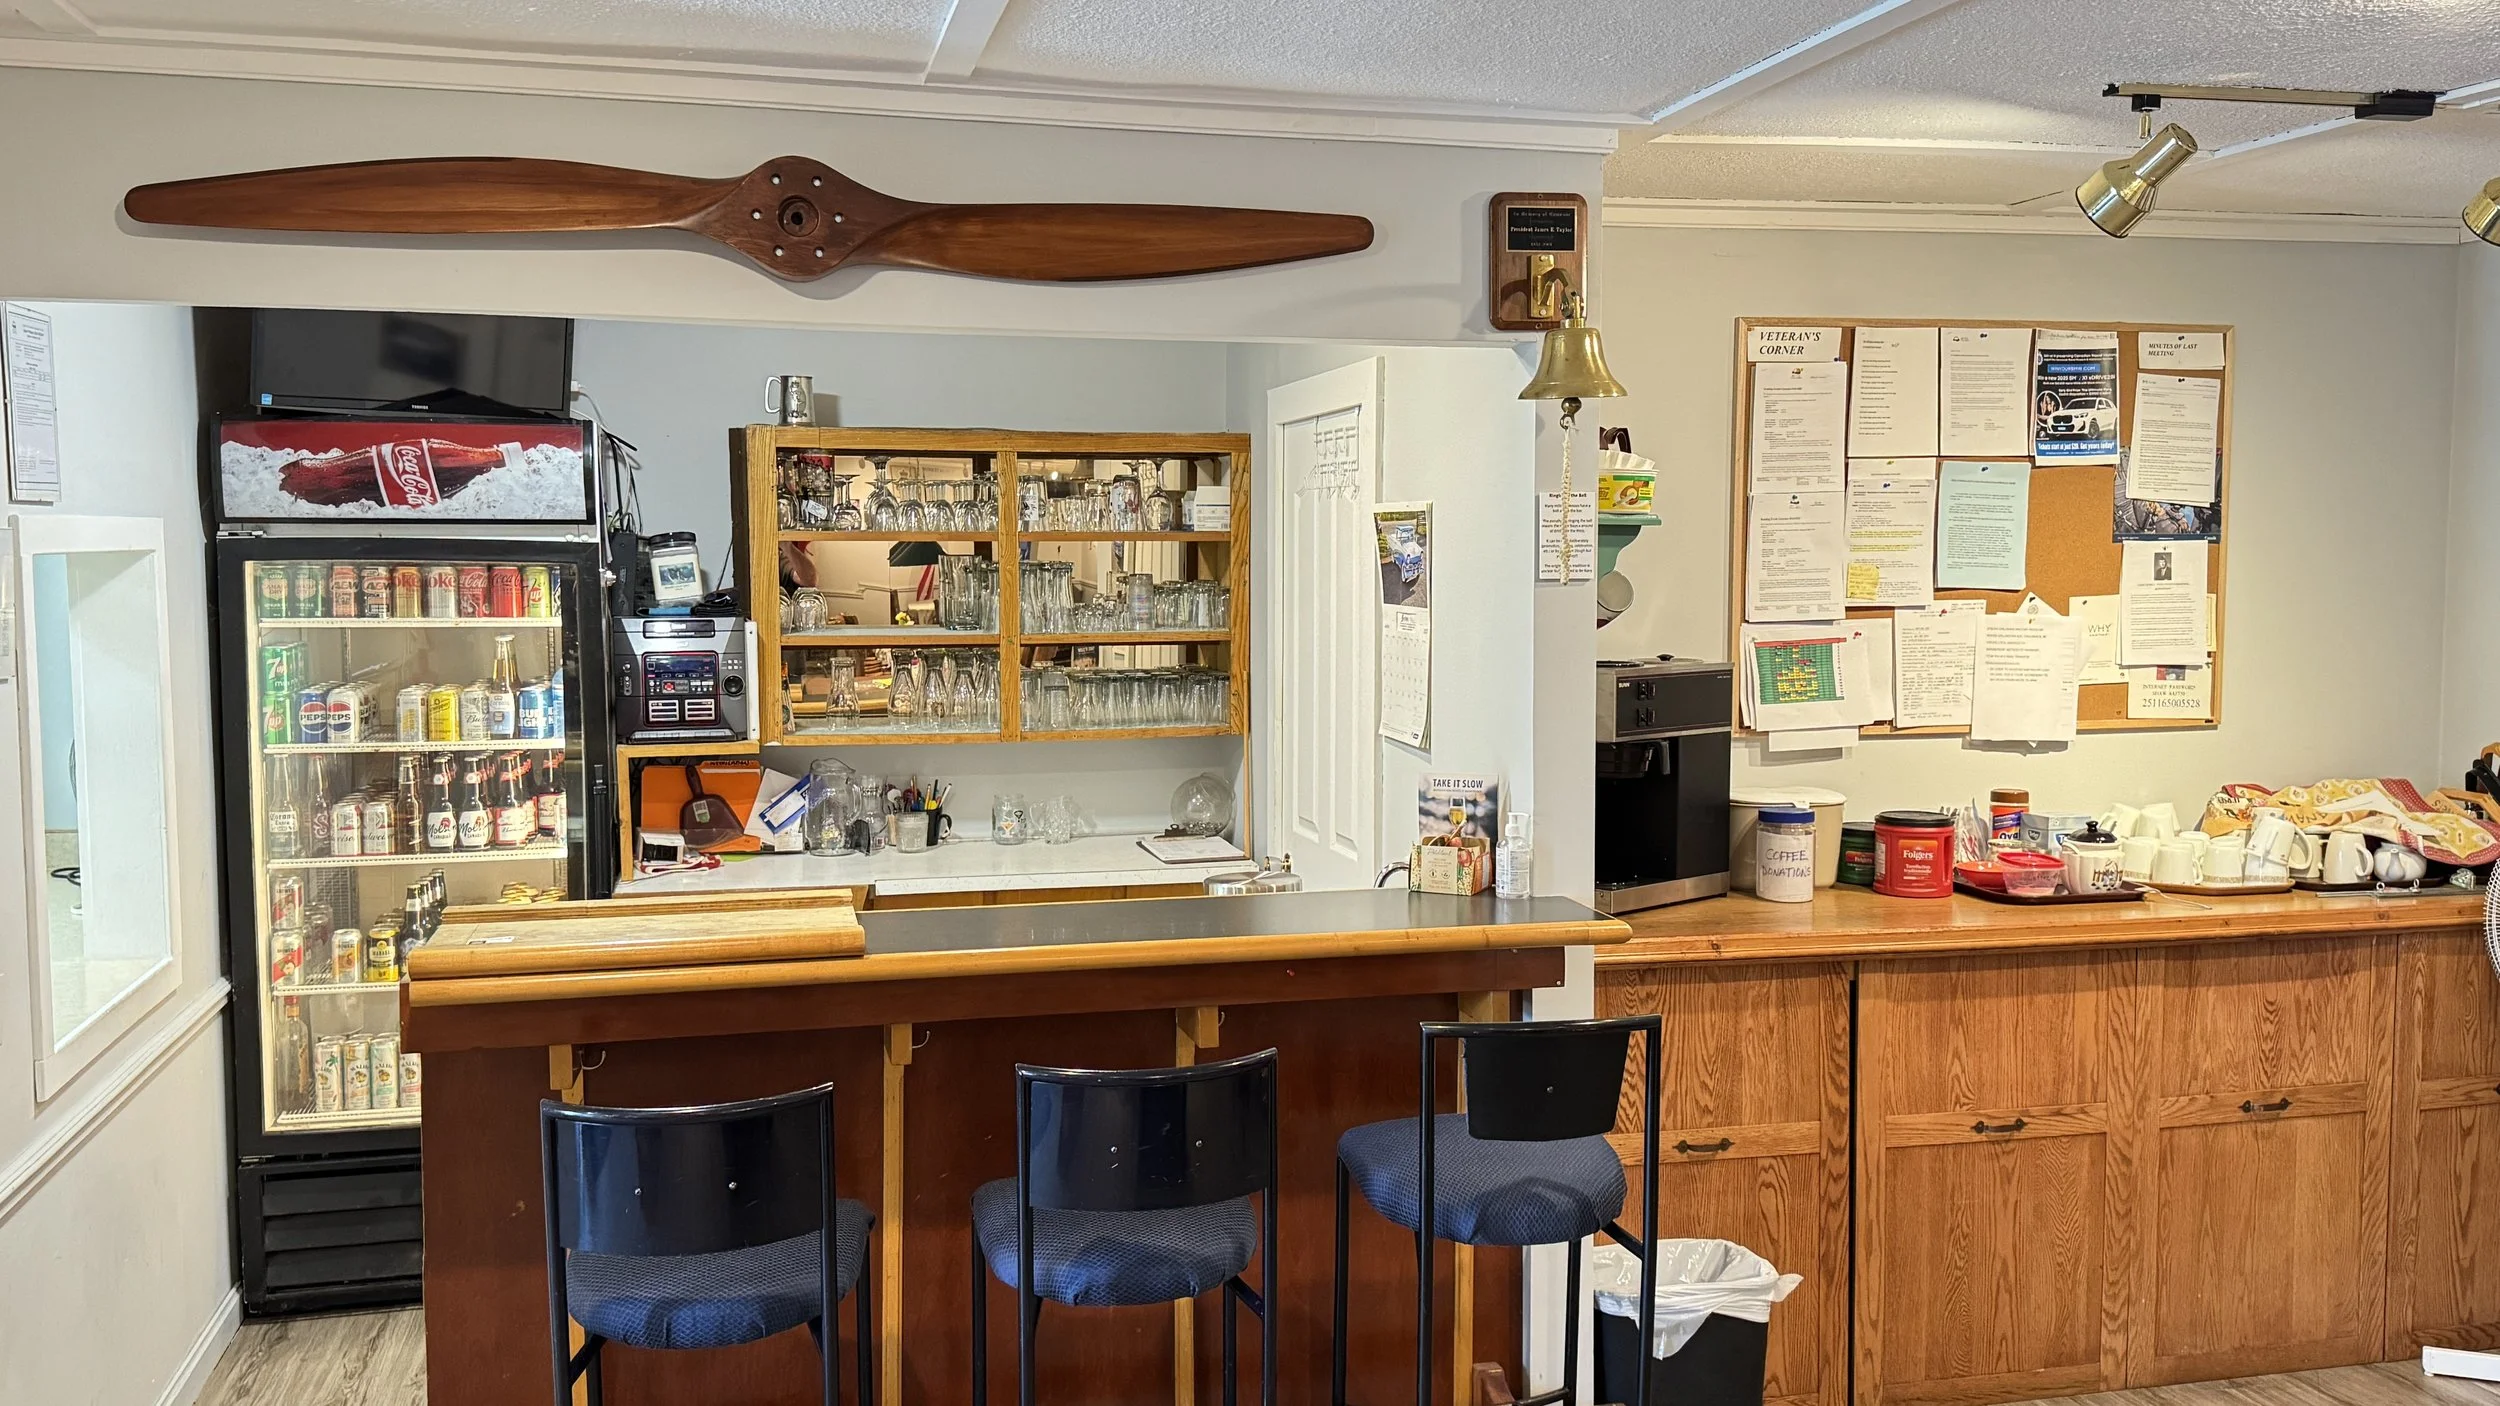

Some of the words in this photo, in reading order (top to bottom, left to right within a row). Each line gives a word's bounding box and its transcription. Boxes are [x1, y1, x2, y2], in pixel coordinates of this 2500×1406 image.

[1760, 331, 1821, 341] VETERAN'S
[1759, 345, 1805, 355] CORNER
[2088, 623, 2112, 633] WHY
[2142, 698, 2201, 708] 251165005528
[300, 713, 327, 721] PEPS
[327, 713, 351, 721] PEPS
[1433, 778, 1451, 788] TAKE
[1453, 779, 1461, 788] IT
[1462, 779, 1484, 789] SLOW
[1766, 849, 1809, 862] COFFEE
[1903, 849, 1934, 861] Folgers
[1761, 865, 1812, 879] DONATIONS
